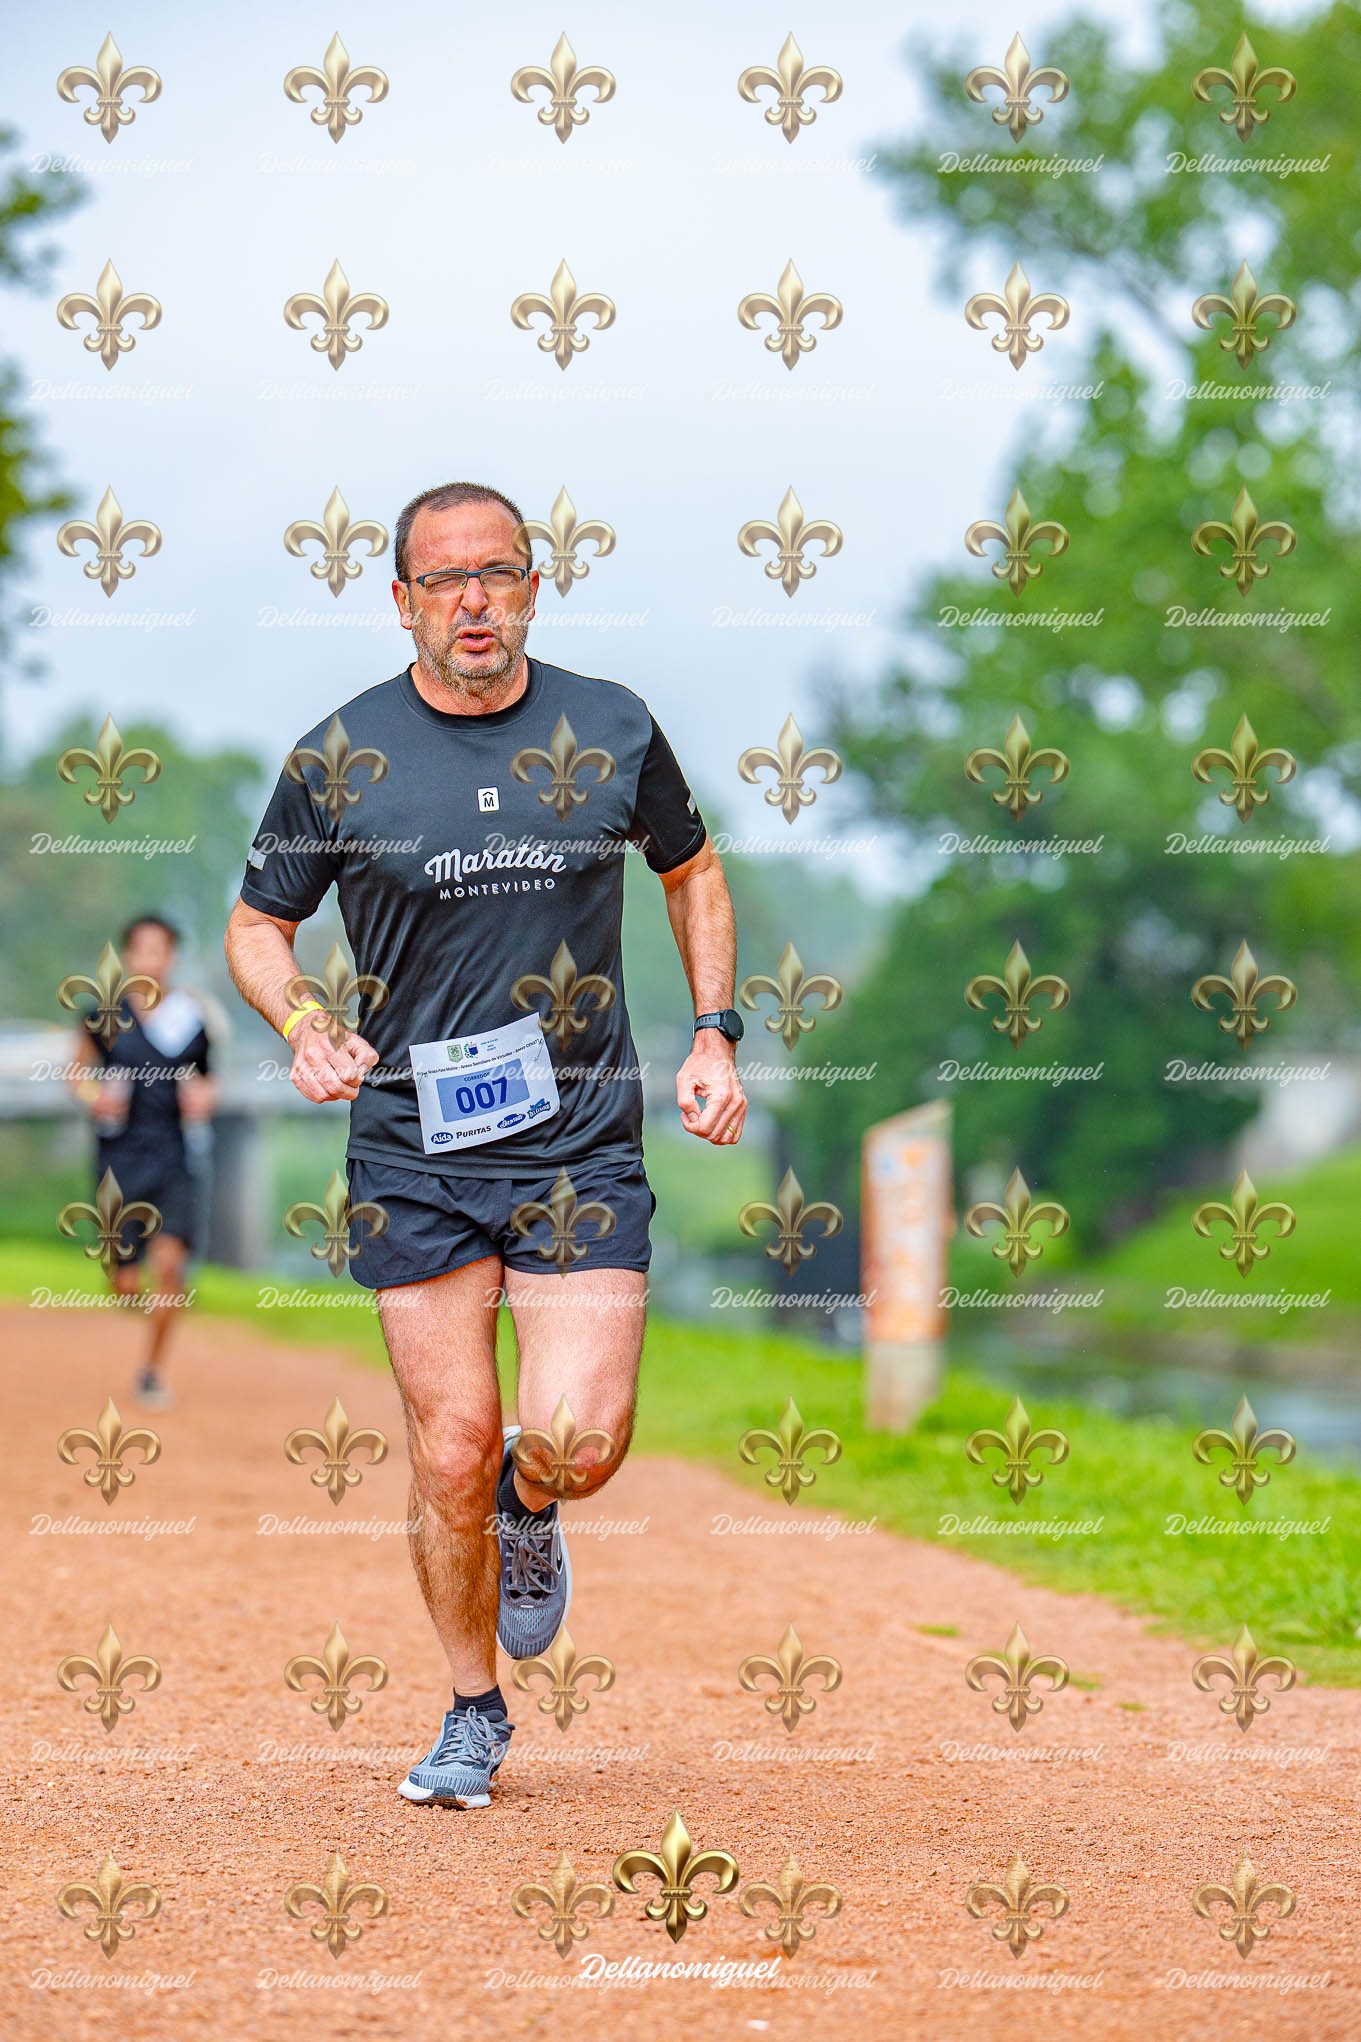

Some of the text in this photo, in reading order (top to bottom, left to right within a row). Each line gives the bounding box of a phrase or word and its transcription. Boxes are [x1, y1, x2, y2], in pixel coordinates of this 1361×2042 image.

[424, 843, 567, 883] Maratón
[439, 878, 556, 900] MONTEVIDEO
[455, 1076, 507, 1114] 007
[455, 1126, 492, 1139] PURITAS
